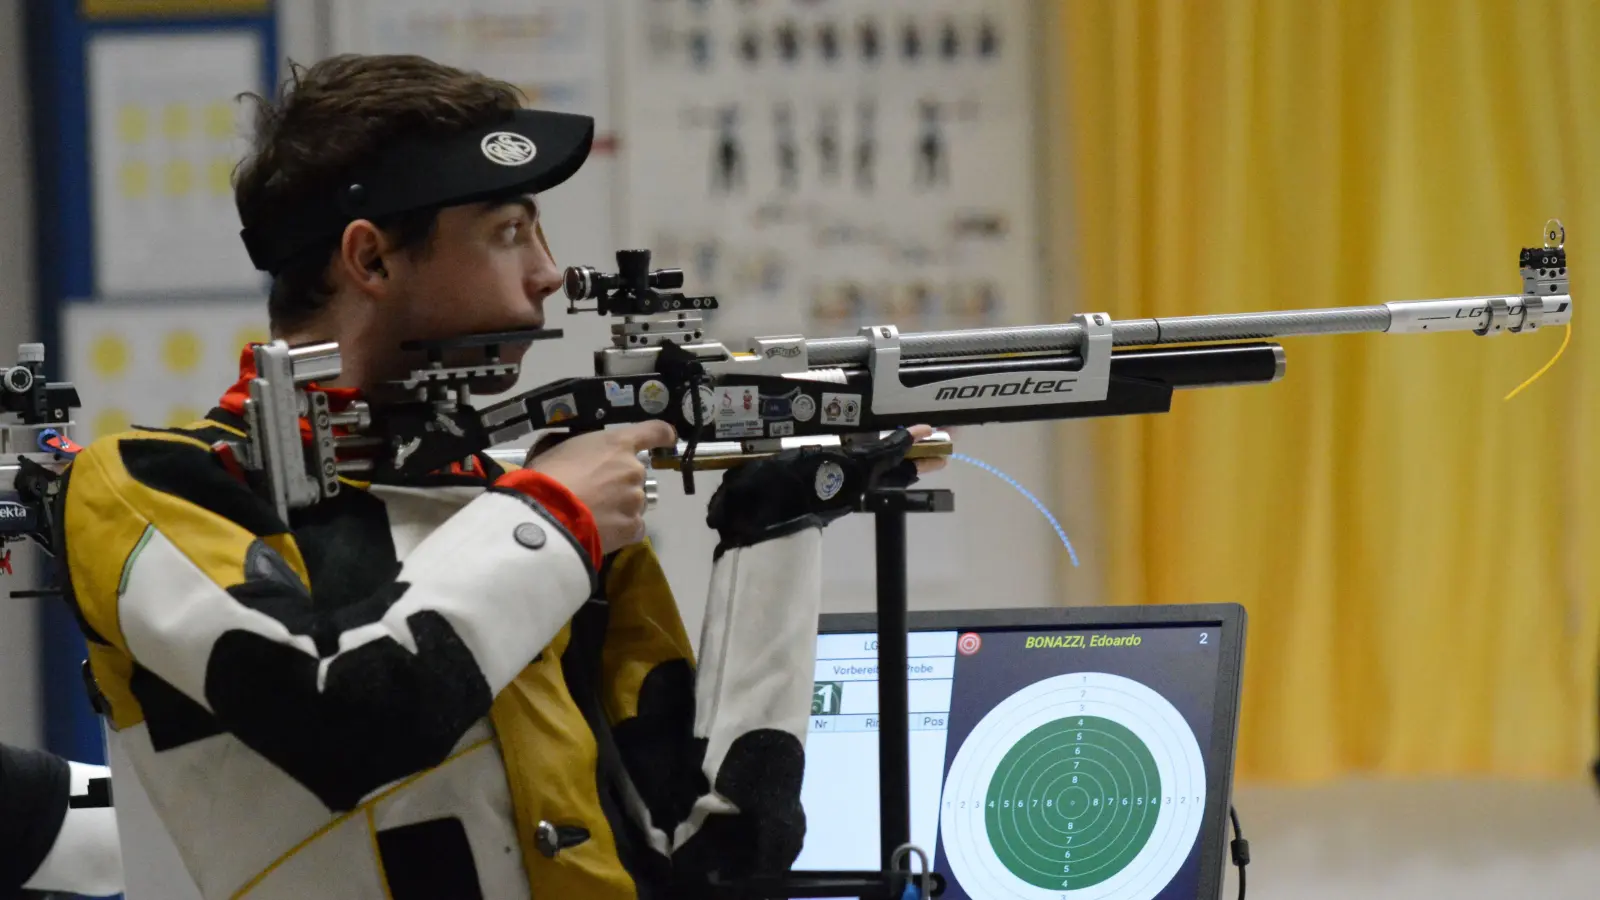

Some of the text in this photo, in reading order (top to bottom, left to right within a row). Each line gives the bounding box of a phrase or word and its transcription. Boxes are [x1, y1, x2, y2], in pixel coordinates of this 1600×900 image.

[934, 377, 1078, 401] monotec
[1025, 634, 1142, 649] BONAZZI, Edoardo
[1199, 632, 1208, 645] 2
[814, 719, 828, 729] Nr
[923, 717, 944, 727] Pos
[1077, 718, 1084, 726] 4
[1076, 732, 1083, 741] 5
[1074, 746, 1081, 755] 6
[1073, 761, 1080, 770] 7
[1071, 775, 1078, 784] 8
[988, 800, 995, 809] 4
[1003, 799, 1010, 808] 5
[1017, 799, 1024, 808] 6
[1032, 799, 1039, 808] 7
[1046, 799, 1053, 808] 8
[1092, 798, 1099, 807] 8
[1107, 797, 1114, 806] 7
[1121, 797, 1128, 806] 6
[1136, 797, 1143, 806] 5
[1150, 797, 1157, 805] 4
[1067, 822, 1074, 830] 8
[1065, 836, 1073, 845] 7
[1064, 850, 1071, 859] 6
[1063, 864, 1070, 873] 5
[1061, 879, 1068, 888] 4
